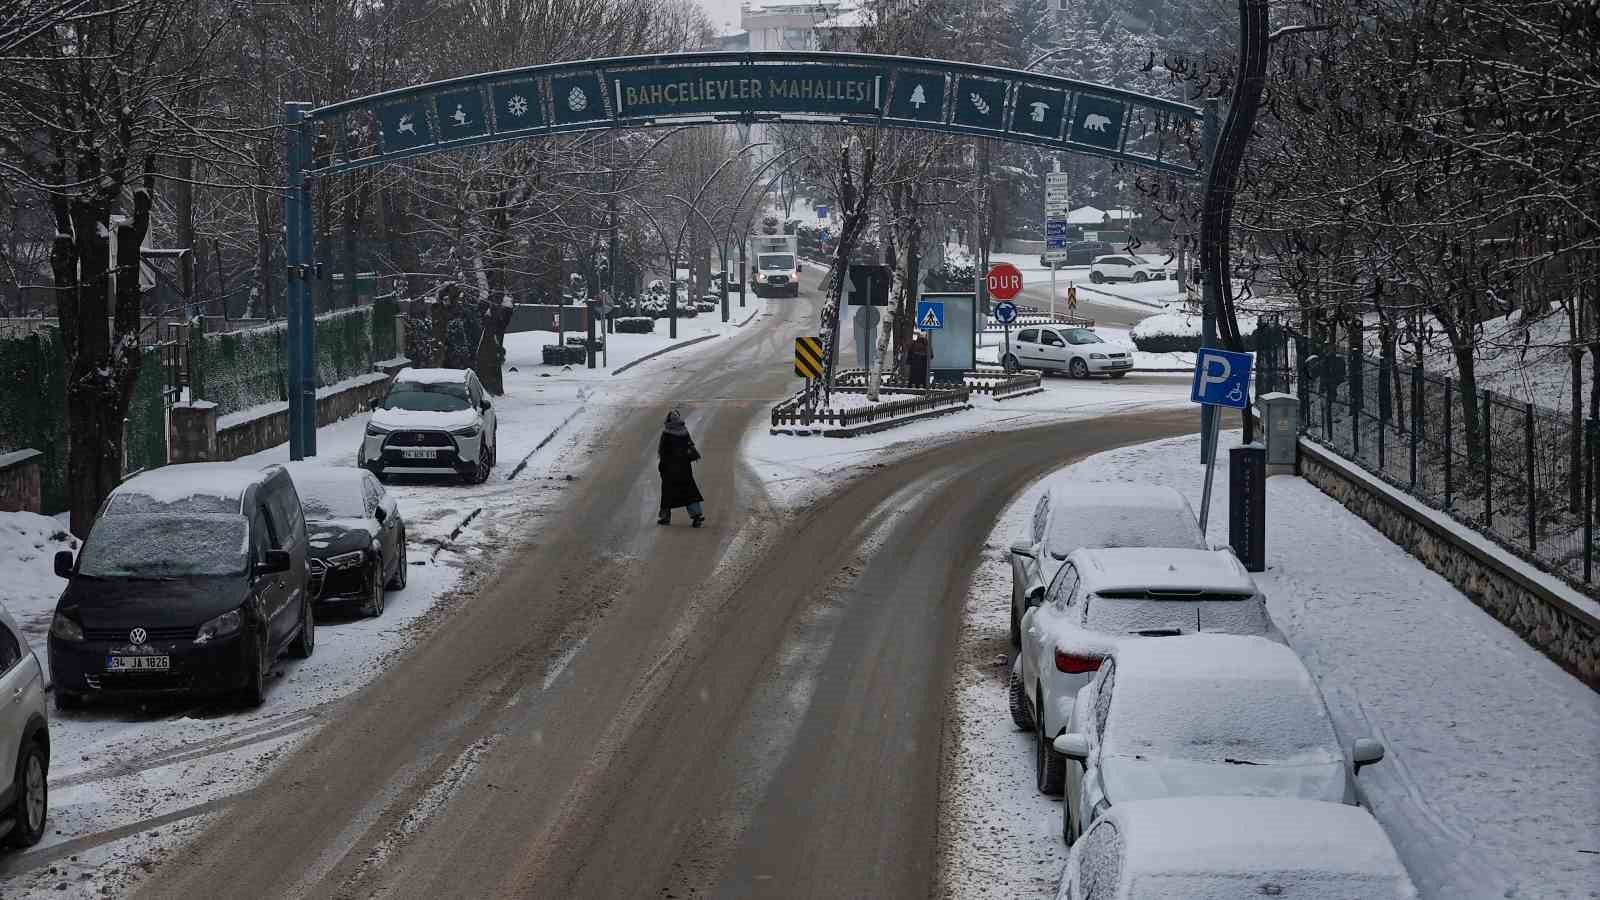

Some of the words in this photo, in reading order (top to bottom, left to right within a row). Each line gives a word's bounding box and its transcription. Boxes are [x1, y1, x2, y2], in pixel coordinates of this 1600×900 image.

[626, 78, 762, 105] BAHÇELİEVLER
[989, 275, 1019, 290] DUR
[1199, 354, 1231, 397] P
[113, 657, 125, 668] 34
[131, 657, 143, 668] JA
